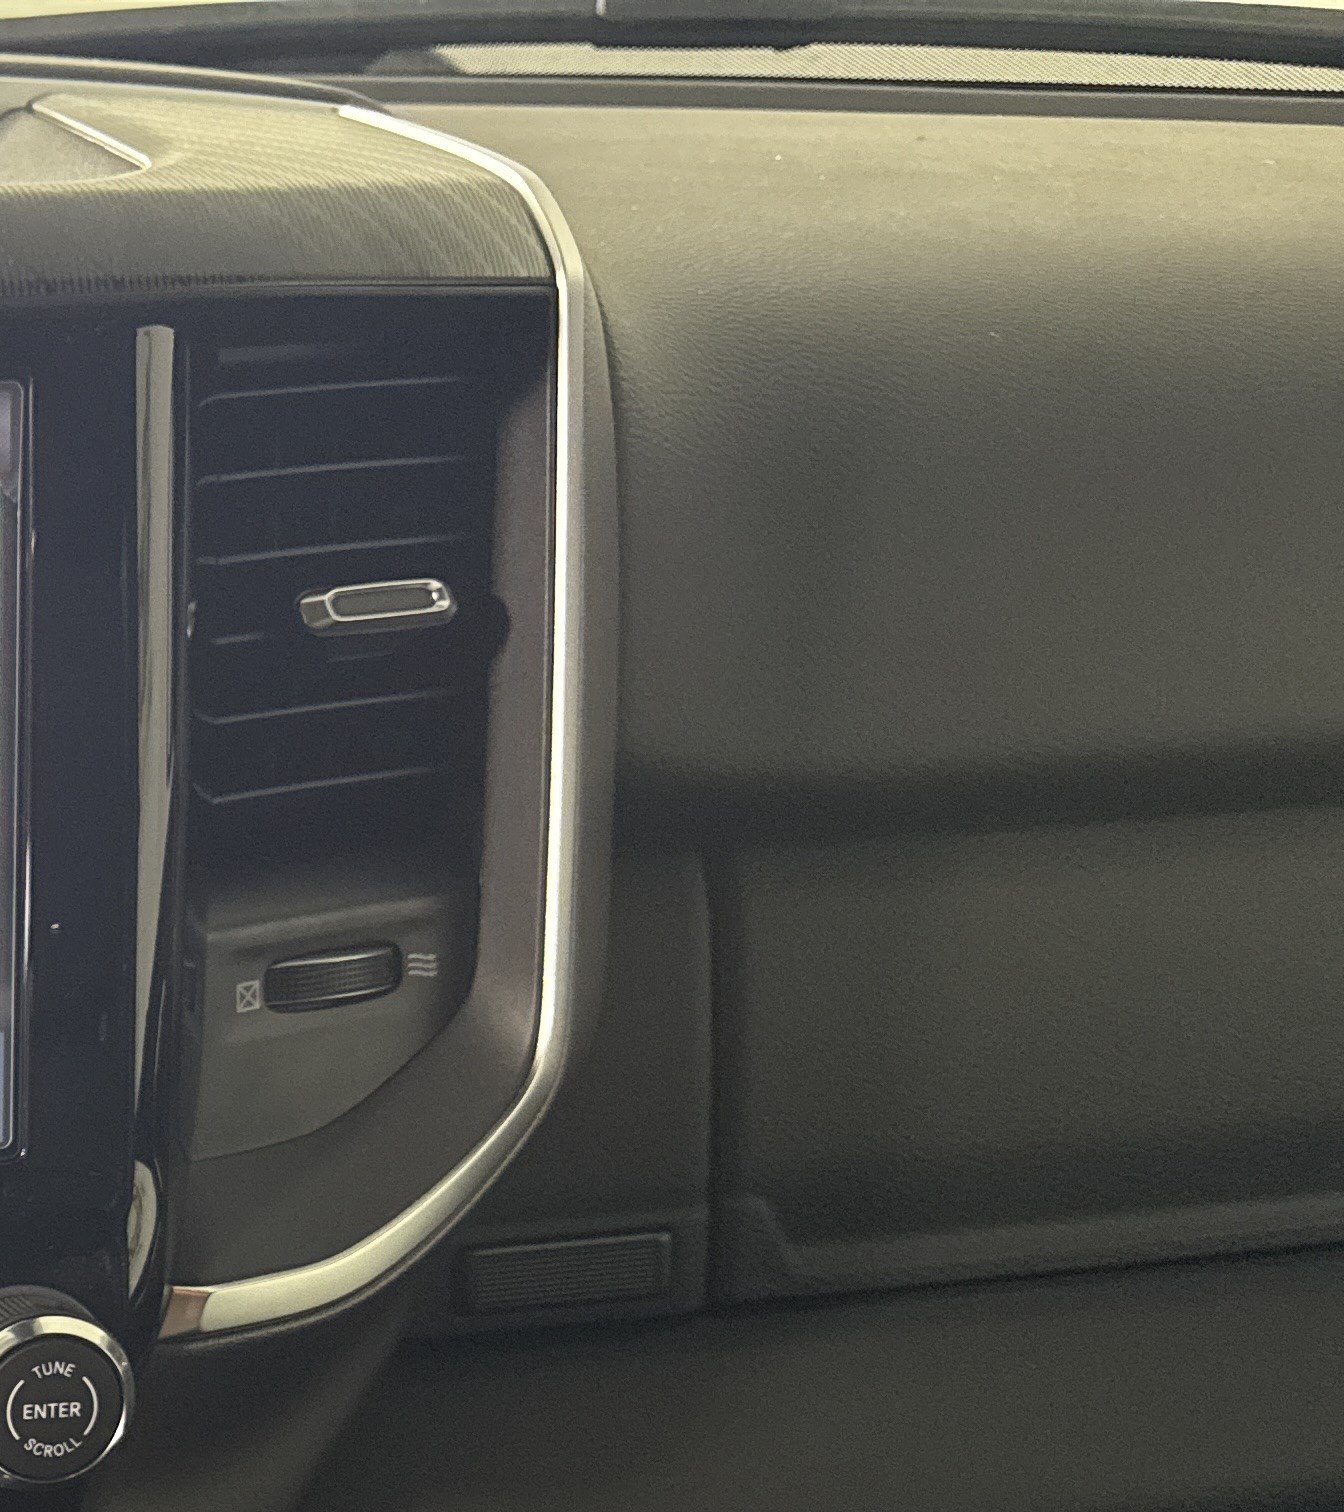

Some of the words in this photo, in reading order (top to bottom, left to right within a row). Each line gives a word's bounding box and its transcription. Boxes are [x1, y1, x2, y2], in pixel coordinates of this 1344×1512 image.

[31, 1360, 76, 1380] TUNE
[22, 1401, 82, 1421] ENTER
[23, 1436, 82, 1459] SCROLL
